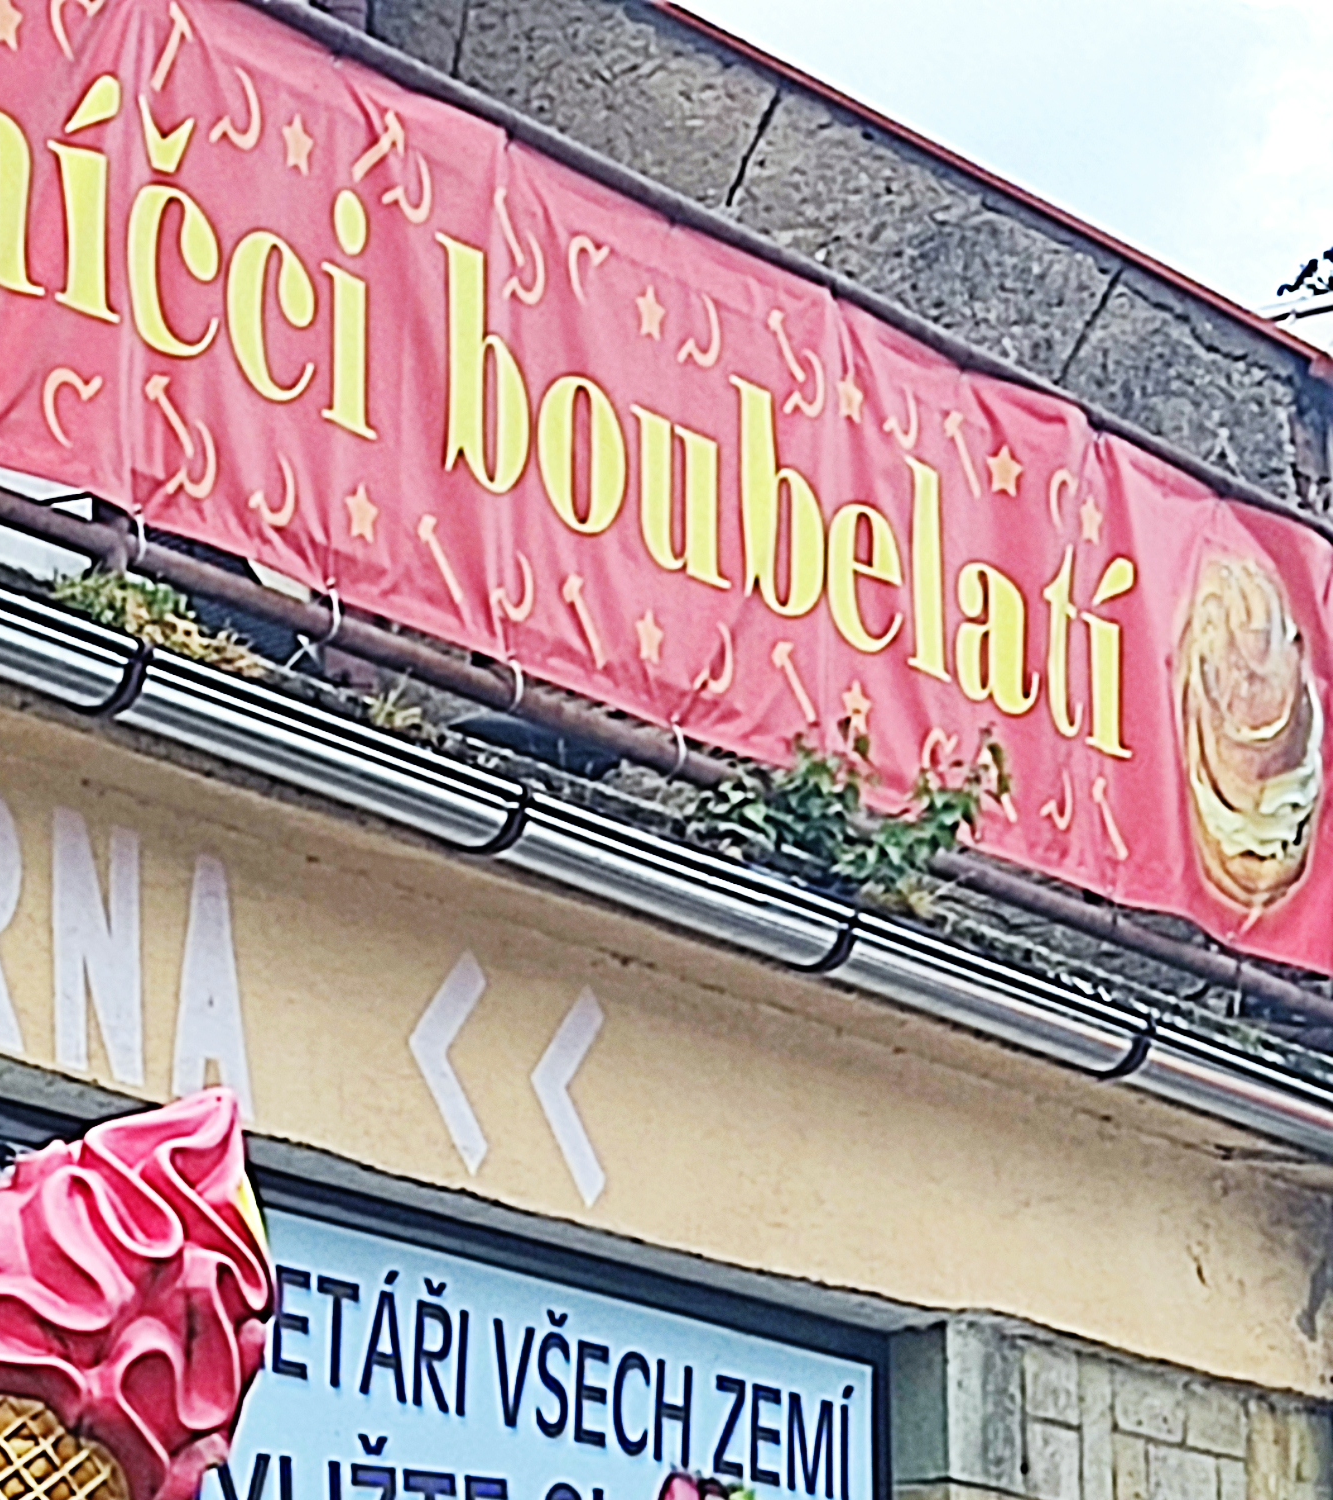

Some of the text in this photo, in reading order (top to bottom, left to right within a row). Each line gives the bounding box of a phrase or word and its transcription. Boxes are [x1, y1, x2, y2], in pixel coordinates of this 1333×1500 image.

[435, 232, 1135, 759] boubelatí
[271, 1263, 468, 1418] ETÁŘI
[492, 1310, 694, 1465] VŠECH
